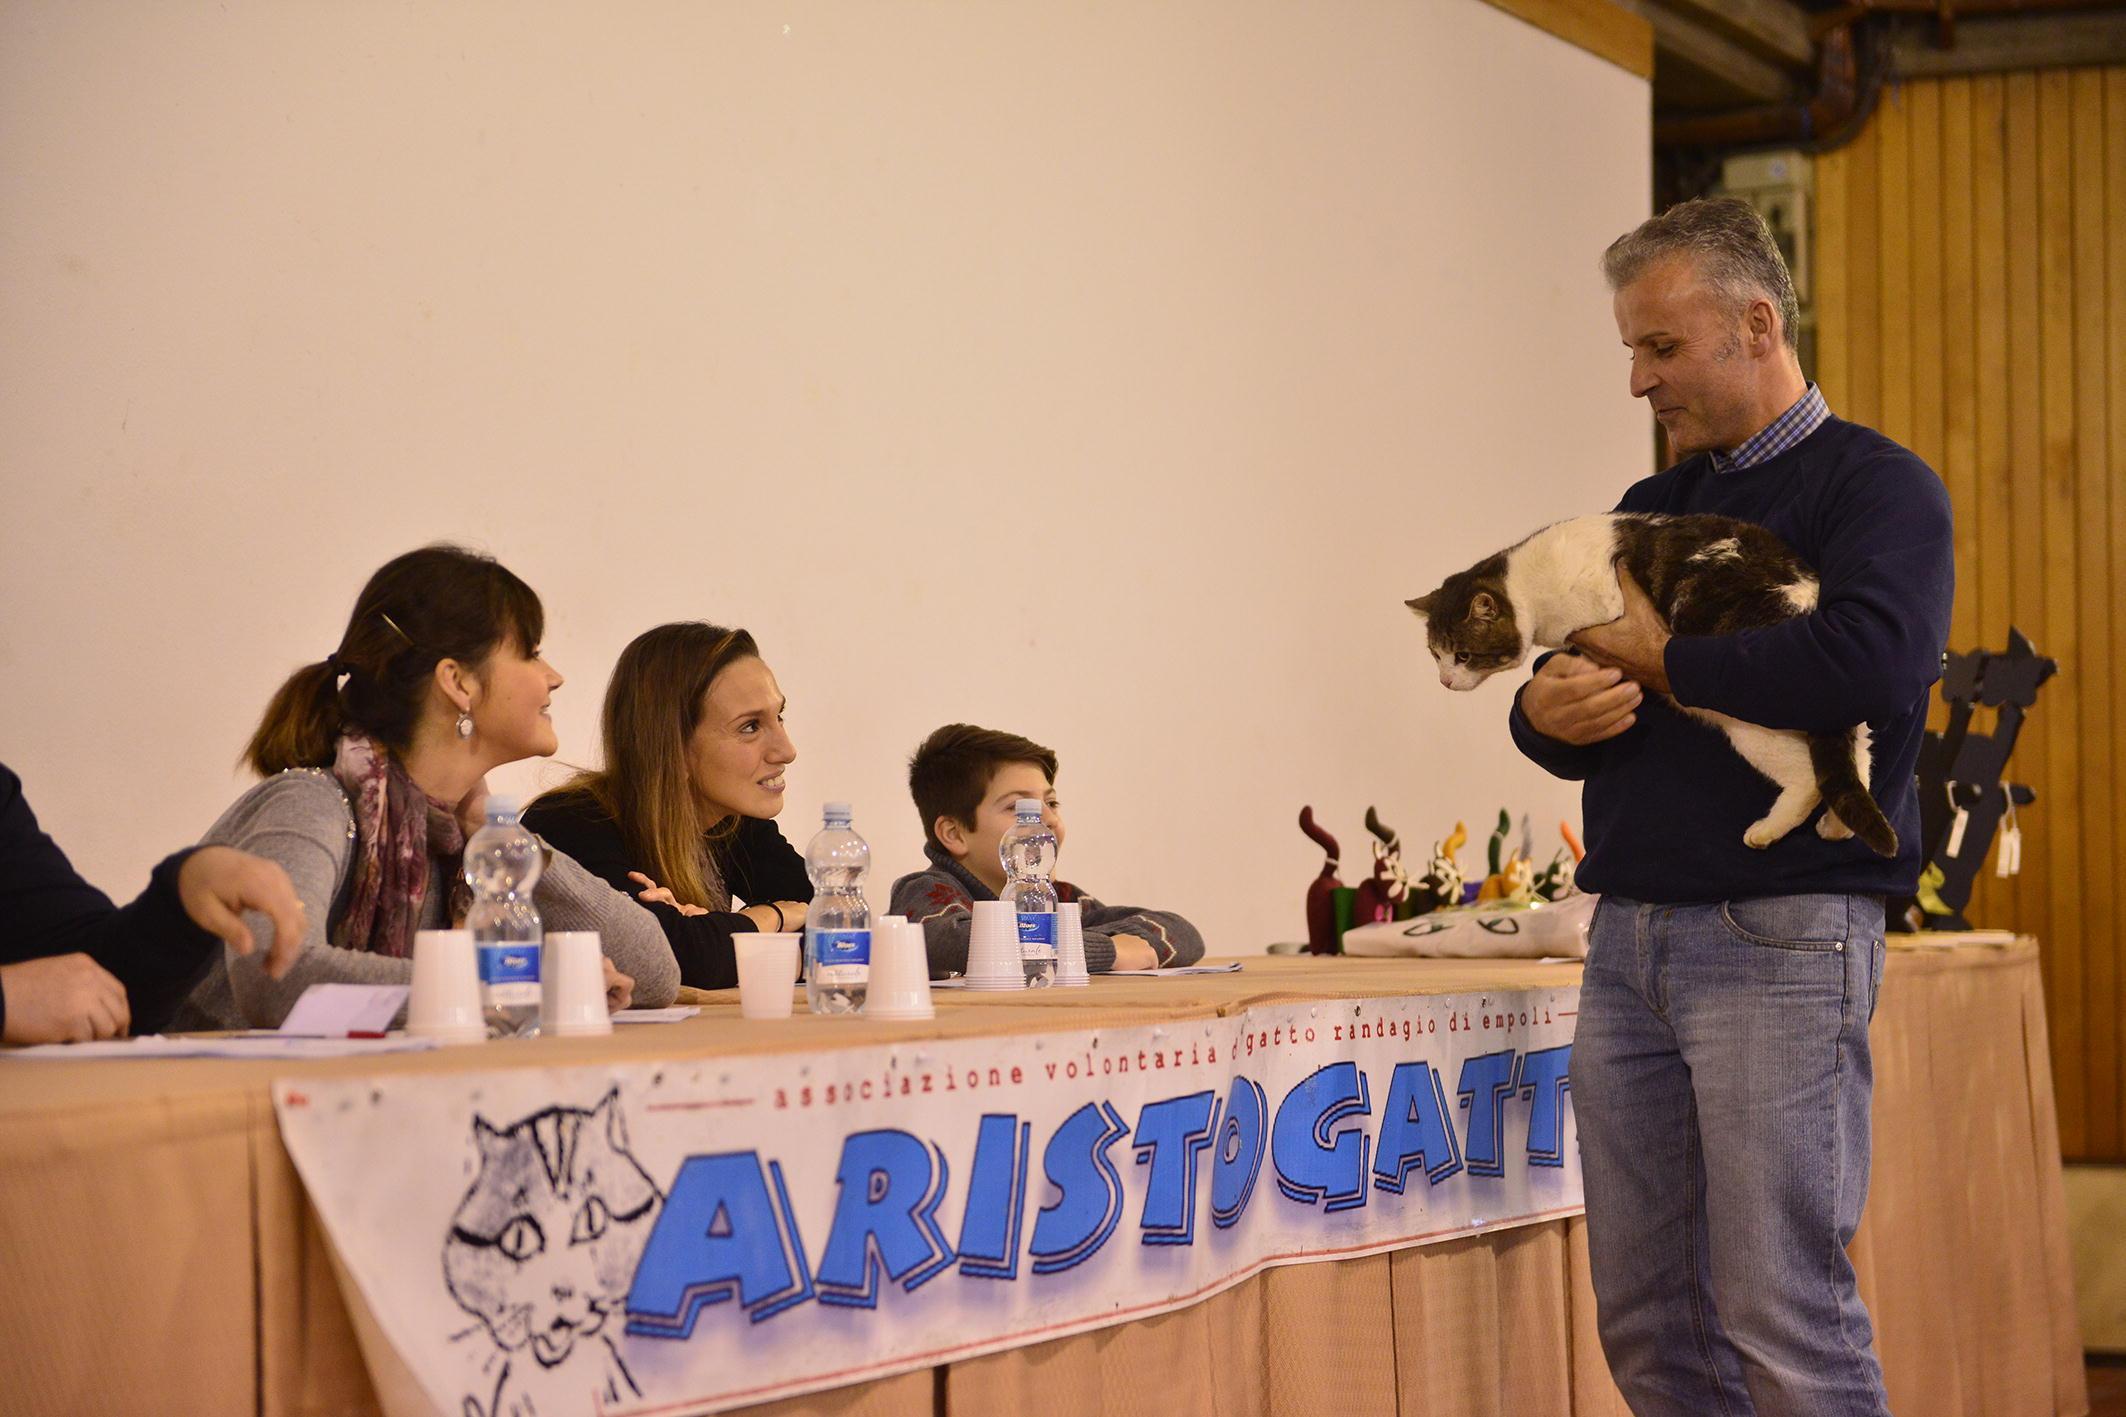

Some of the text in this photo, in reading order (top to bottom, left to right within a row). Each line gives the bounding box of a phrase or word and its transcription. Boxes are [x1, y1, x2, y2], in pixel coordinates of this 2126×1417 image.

[774, 1066, 1023, 1110] associazione
[1044, 1041, 1217, 1081] volontaria
[1245, 1023, 1316, 1056] gatto
[1333, 1014, 1437, 1042] randagio
[1449, 1009, 1471, 1032] di
[1482, 1005, 1553, 1034] empoli
[624, 1043, 1574, 1341] ARISTOGATT
